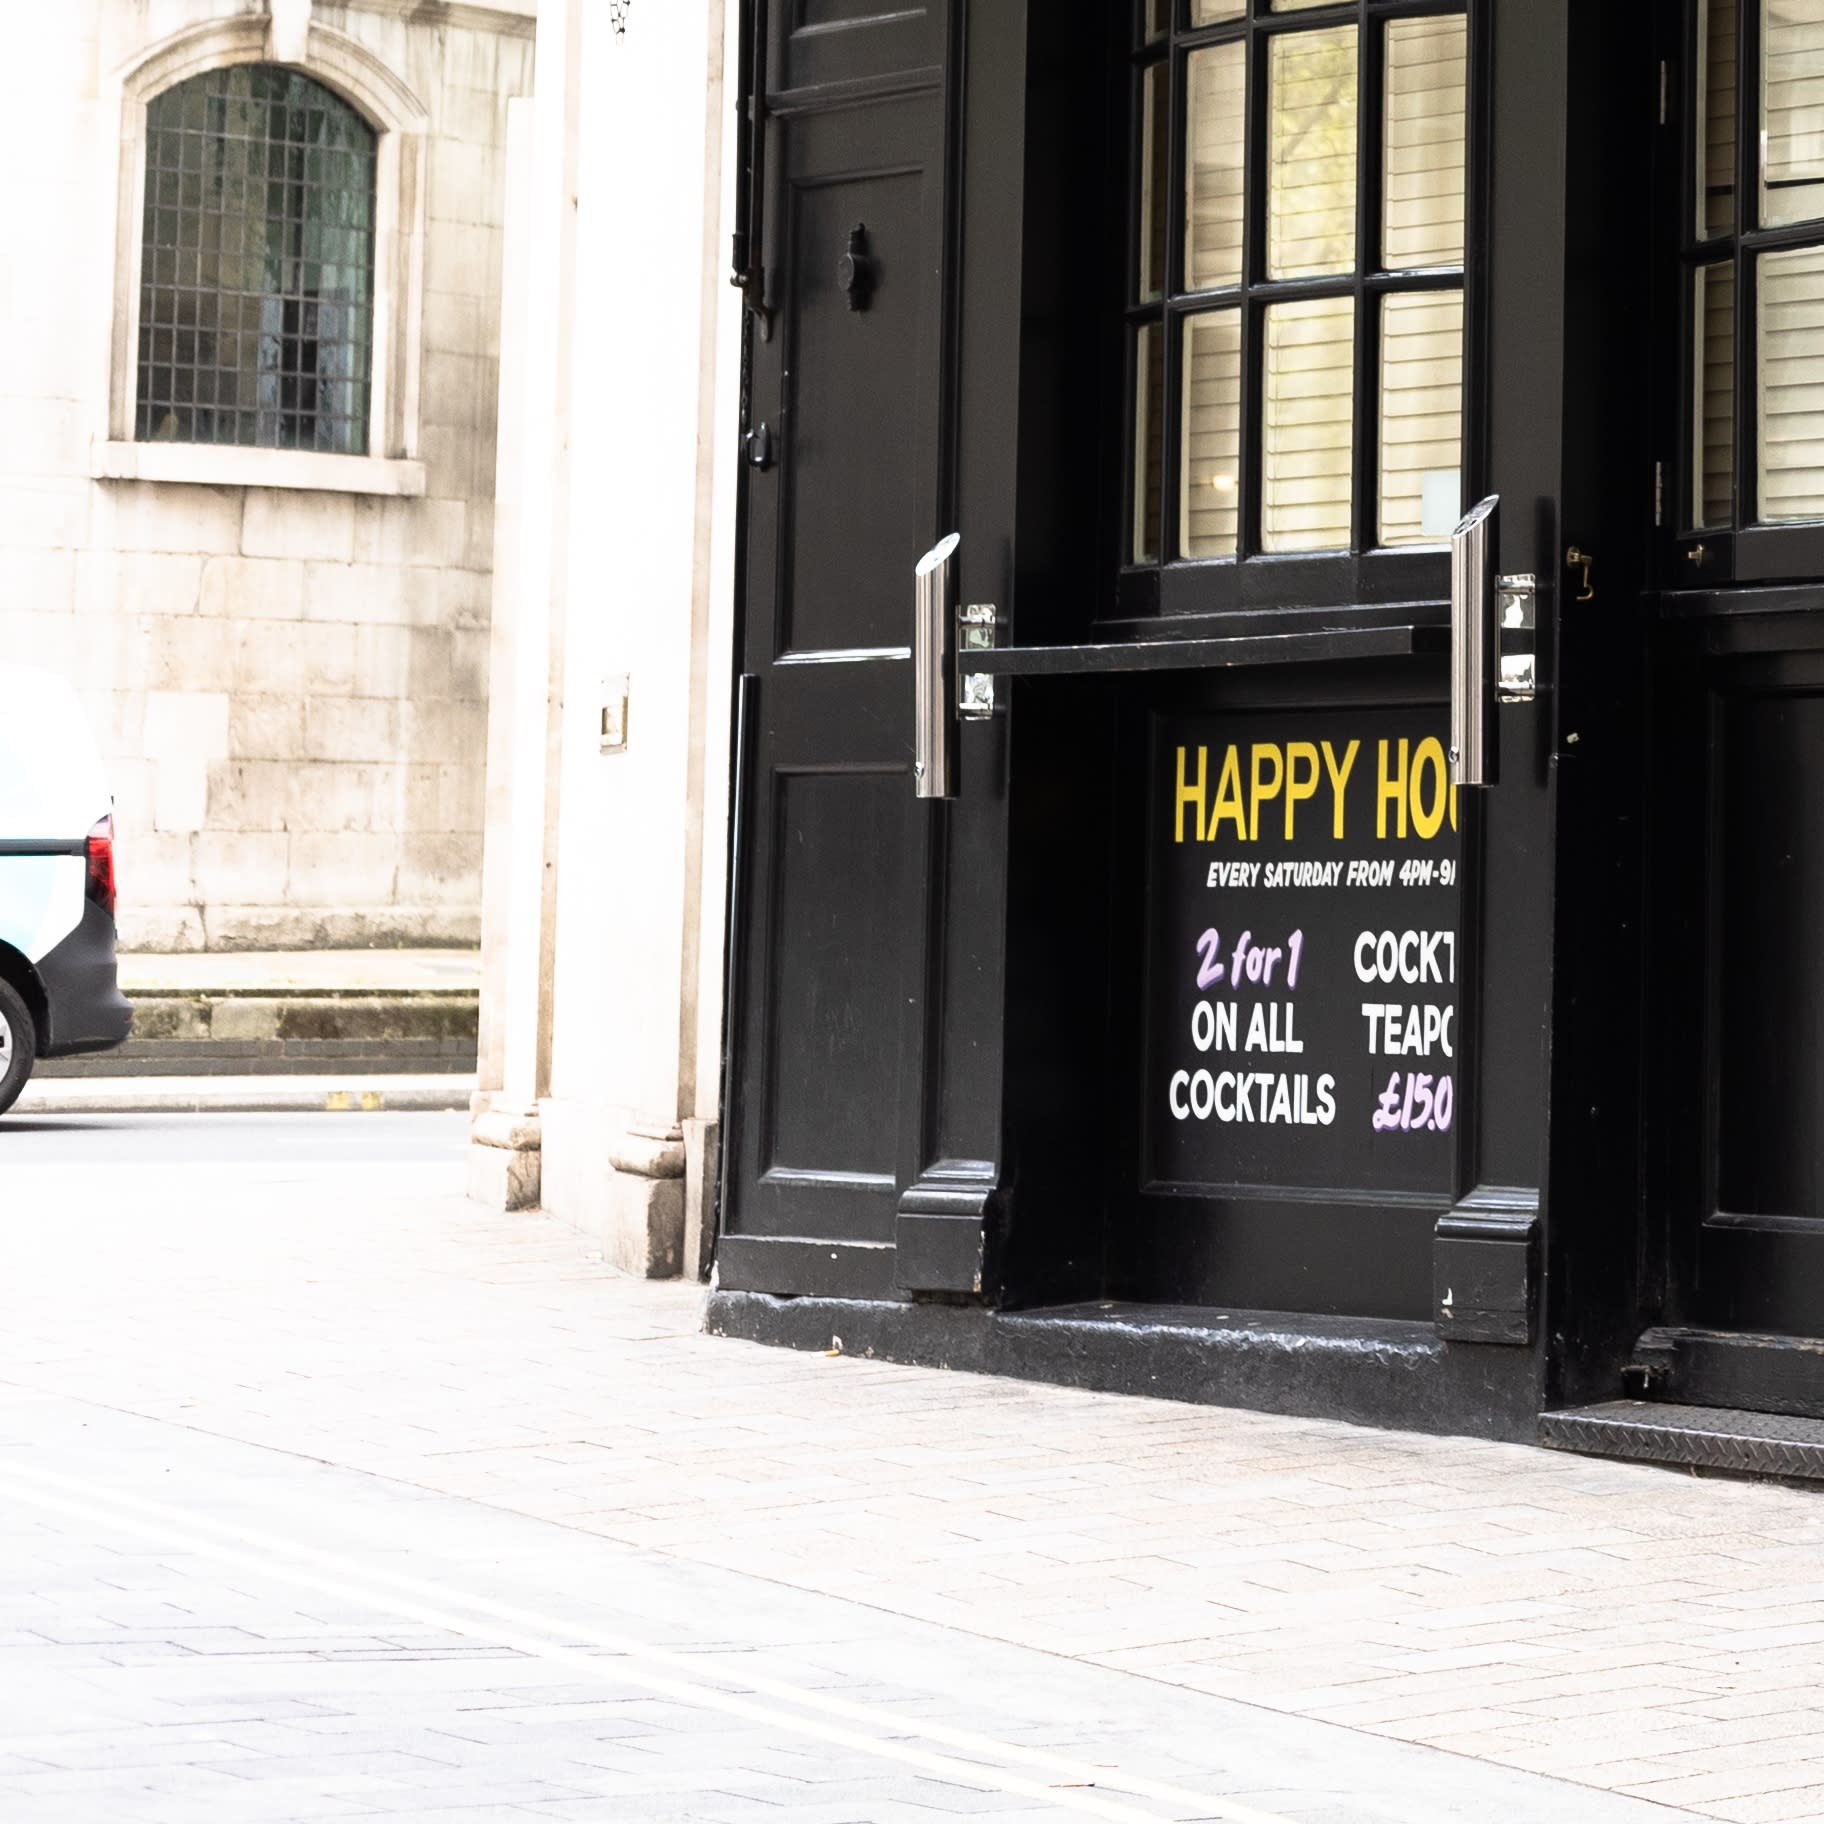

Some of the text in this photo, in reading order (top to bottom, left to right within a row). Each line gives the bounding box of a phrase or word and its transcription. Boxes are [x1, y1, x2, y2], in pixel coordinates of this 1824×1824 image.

[1174, 736, 1456, 843] HAPPY HO
[1206, 861, 1261, 888] EVERY
[1263, 861, 1344, 888] SATURDAY
[1346, 860, 1395, 887] FROM
[1196, 928, 1304, 991] 2 for 1
[1191, 1000, 1304, 1054] ON ALL
[1169, 1069, 1336, 1126] COCKTAILS
